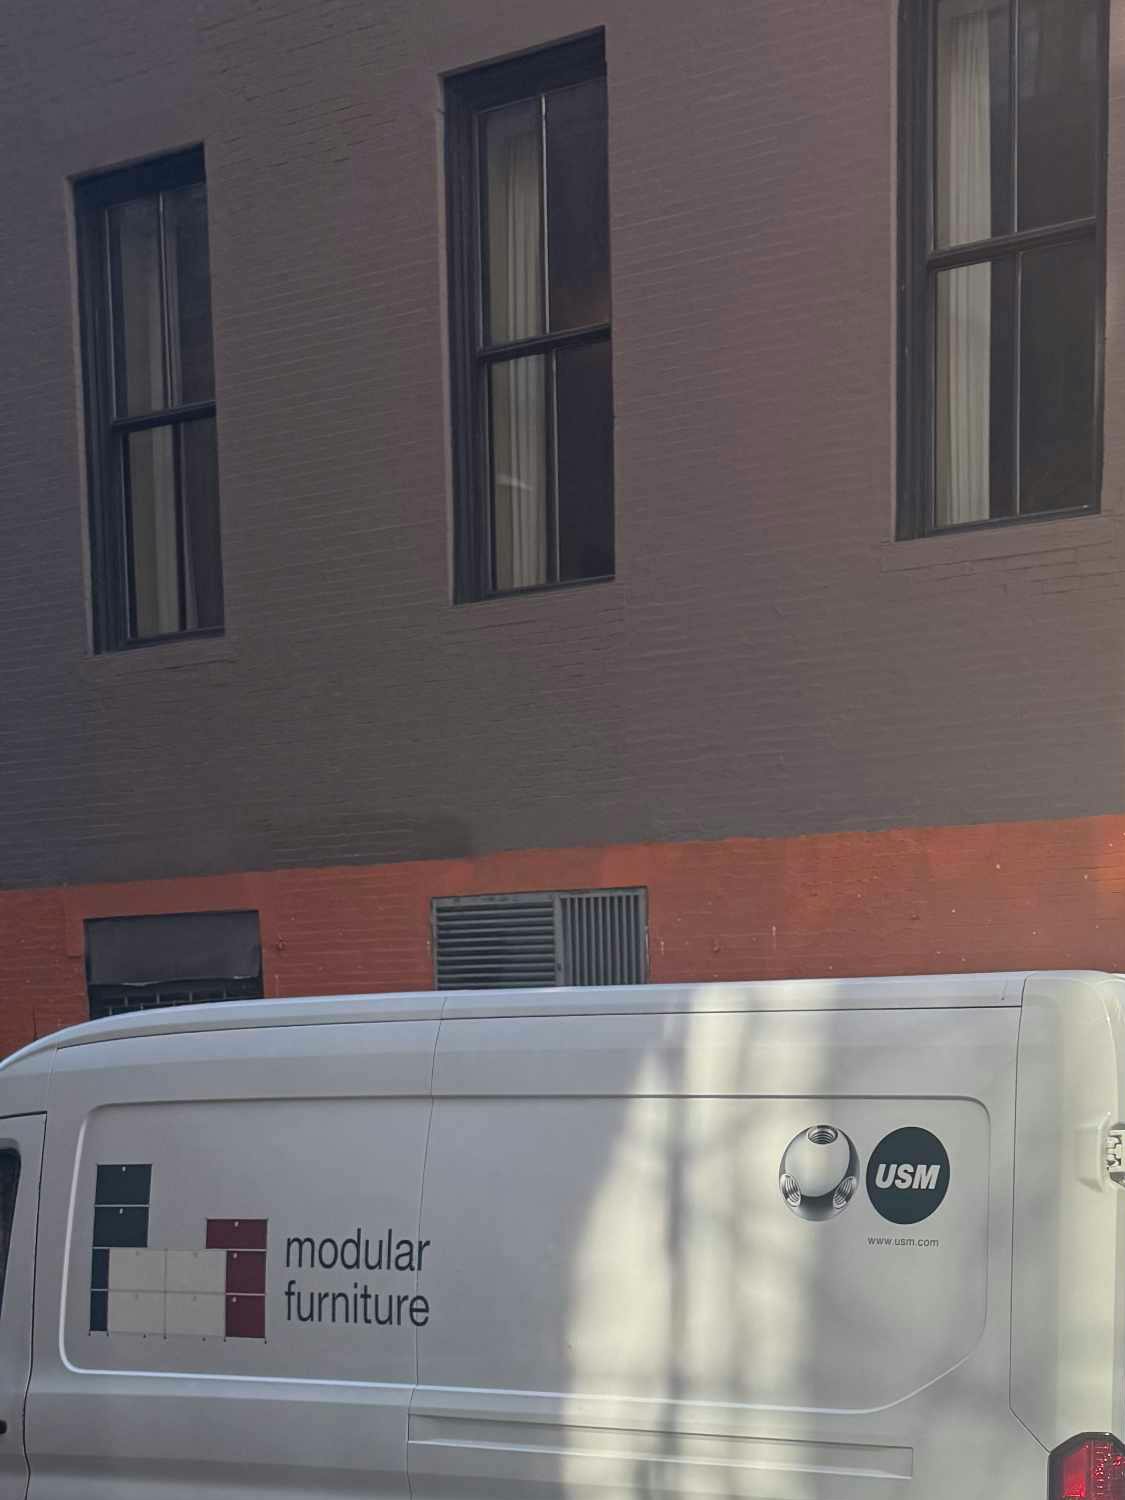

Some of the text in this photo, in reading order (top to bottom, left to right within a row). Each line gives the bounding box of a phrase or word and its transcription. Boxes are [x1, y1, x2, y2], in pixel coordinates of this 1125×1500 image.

[874, 1163, 941, 1190] USM
[285, 1228, 431, 1272] modular
[867, 1236, 940, 1248] www.usm.com
[285, 1280, 430, 1327] furniture
